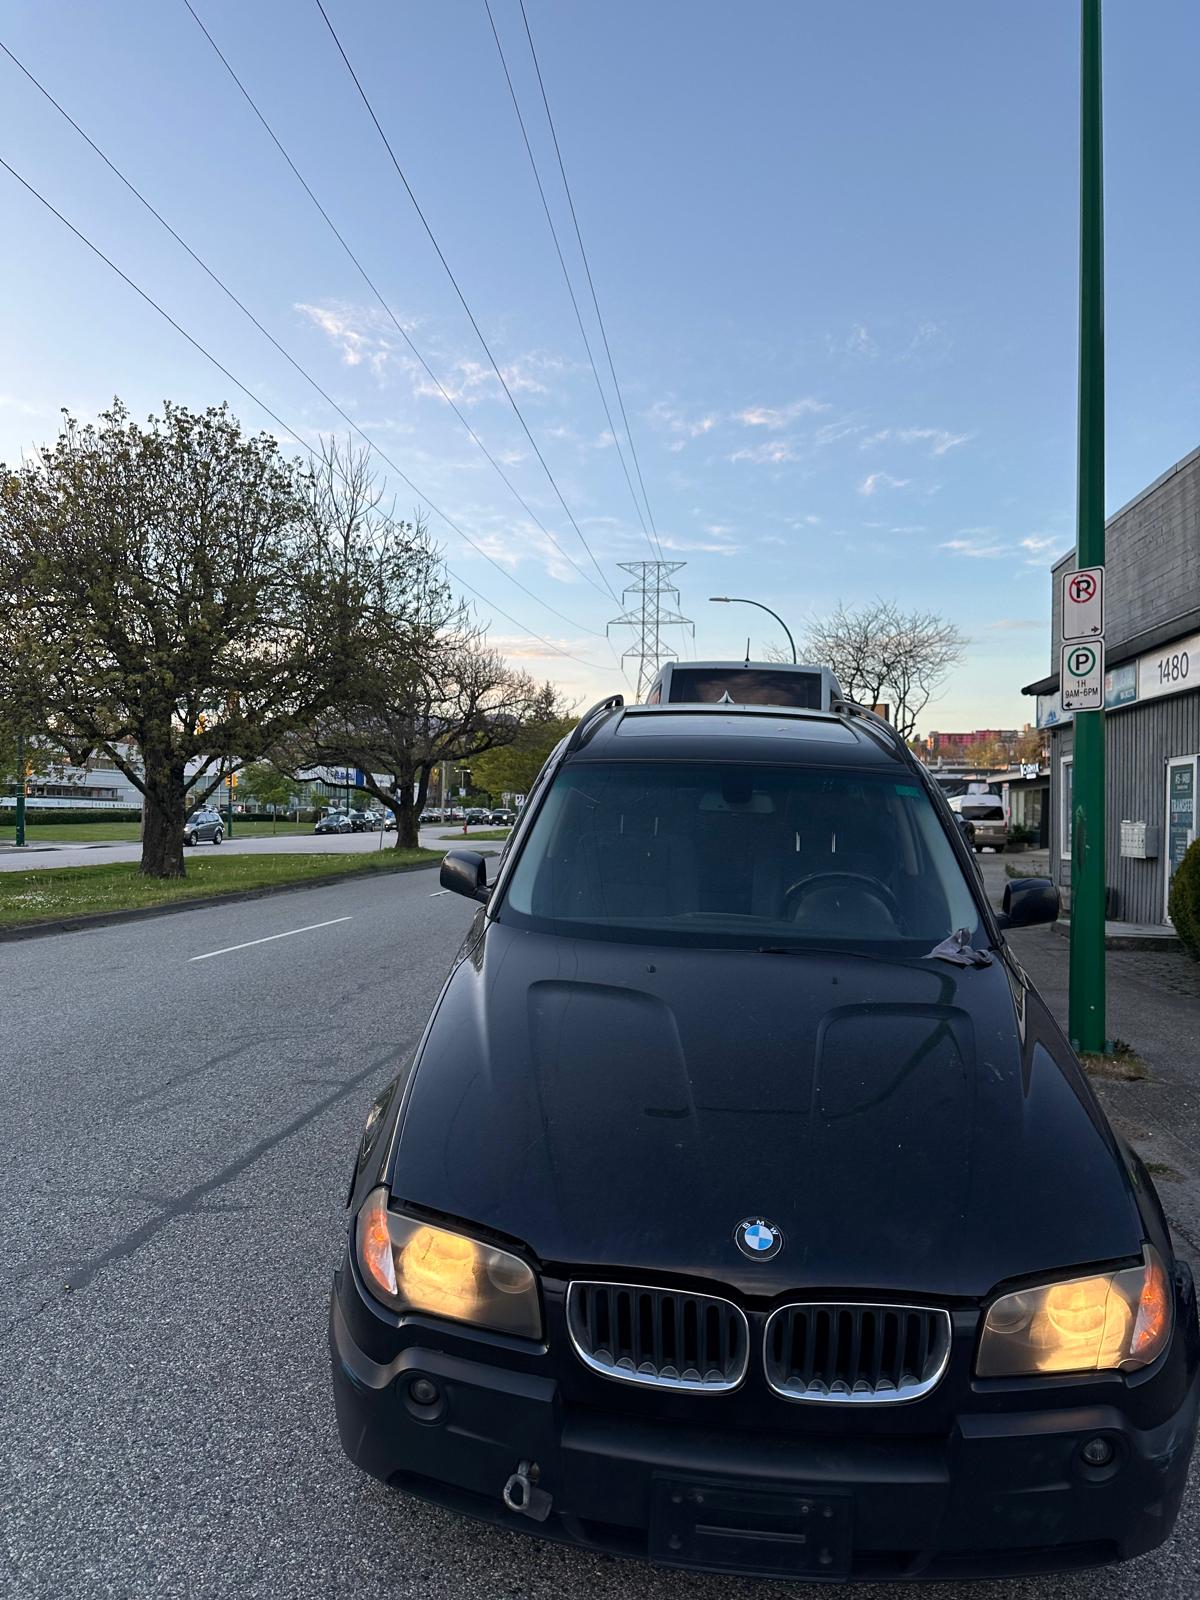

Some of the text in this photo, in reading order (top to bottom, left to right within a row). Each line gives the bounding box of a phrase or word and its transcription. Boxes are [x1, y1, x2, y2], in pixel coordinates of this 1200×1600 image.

[1075, 653, 1089, 670] P
[1158, 652, 1189, 684] 1480
[1065, 687, 1098, 698] 9AM-6PM
[742, 1220, 778, 1235] BMW
